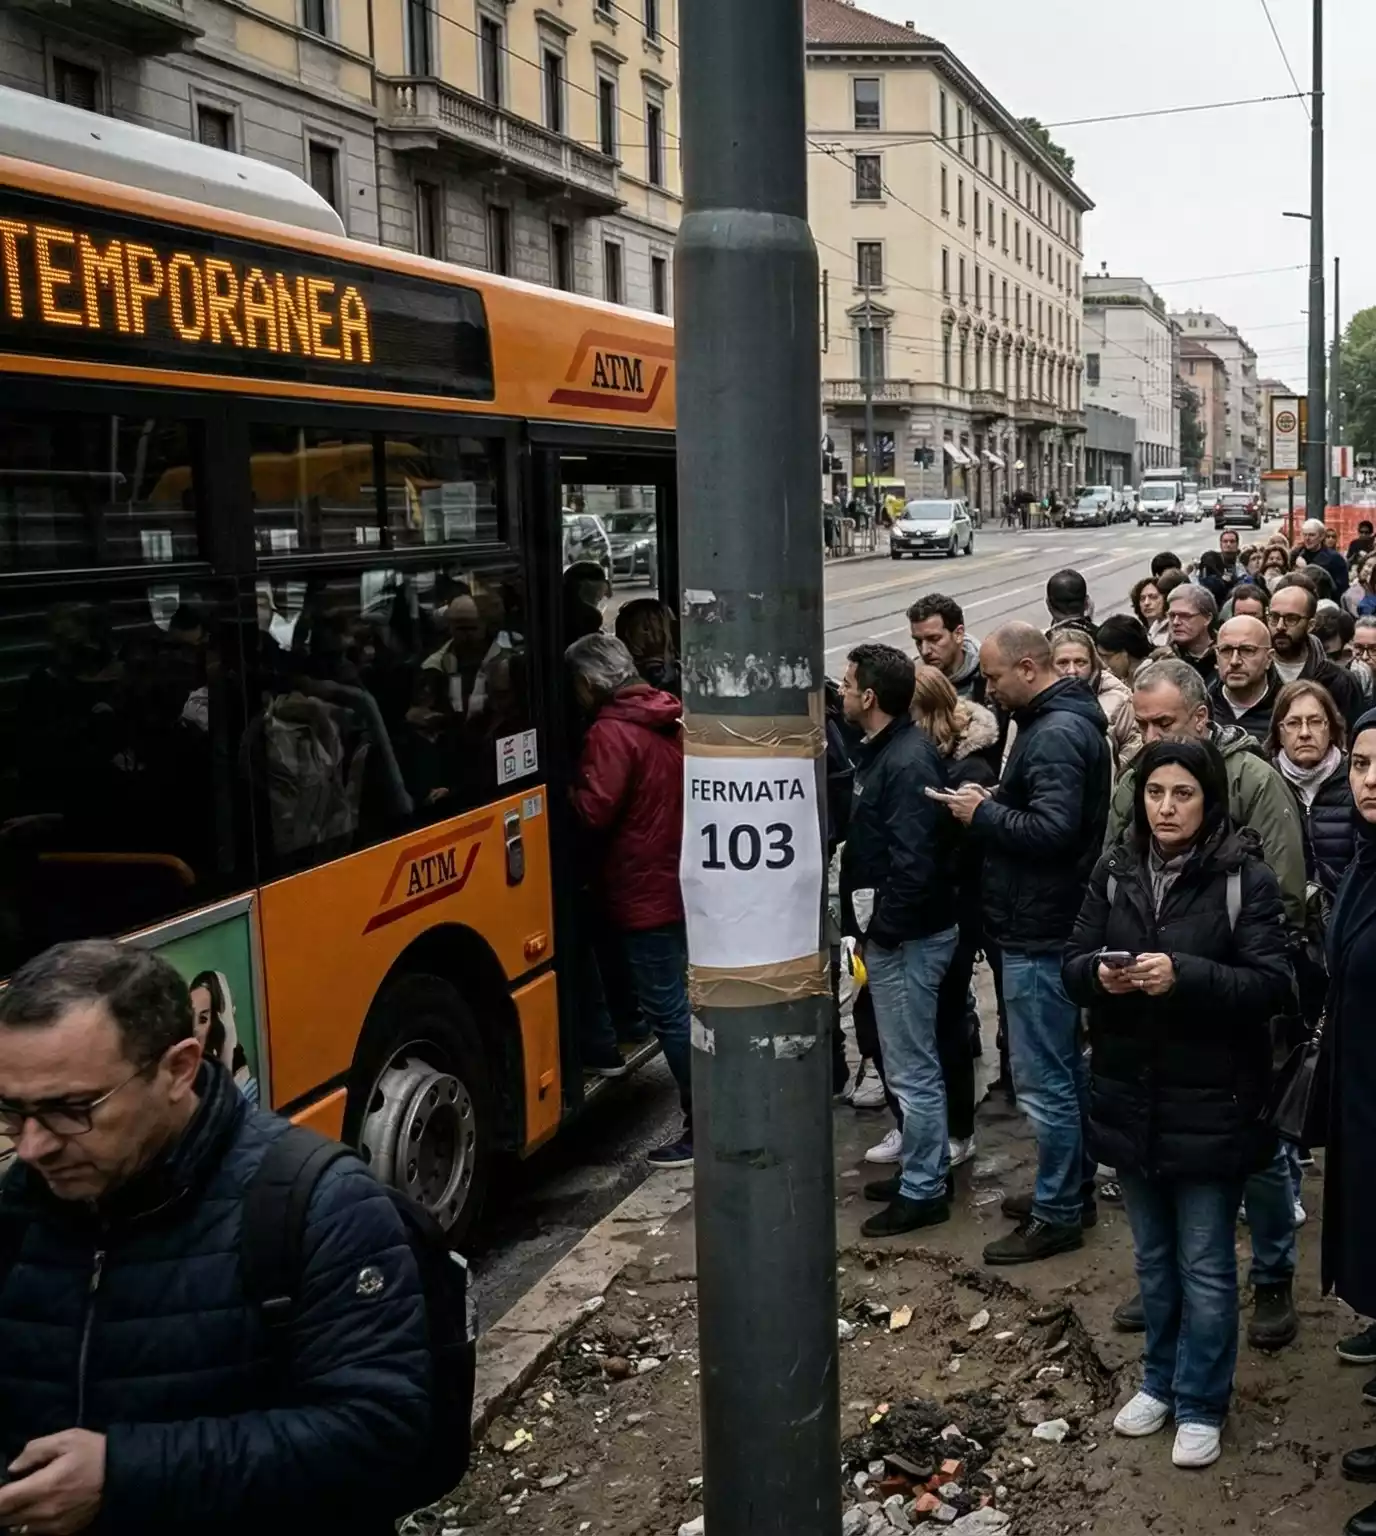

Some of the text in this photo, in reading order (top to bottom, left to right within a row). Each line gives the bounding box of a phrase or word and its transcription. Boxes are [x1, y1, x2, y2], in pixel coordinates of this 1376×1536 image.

[0, 219, 371, 363] TEMPORANEA
[591, 352, 645, 393] ATM
[691, 777, 806, 803] FERMATA
[700, 822, 796, 871] 103
[406, 847, 458, 897] ATM
